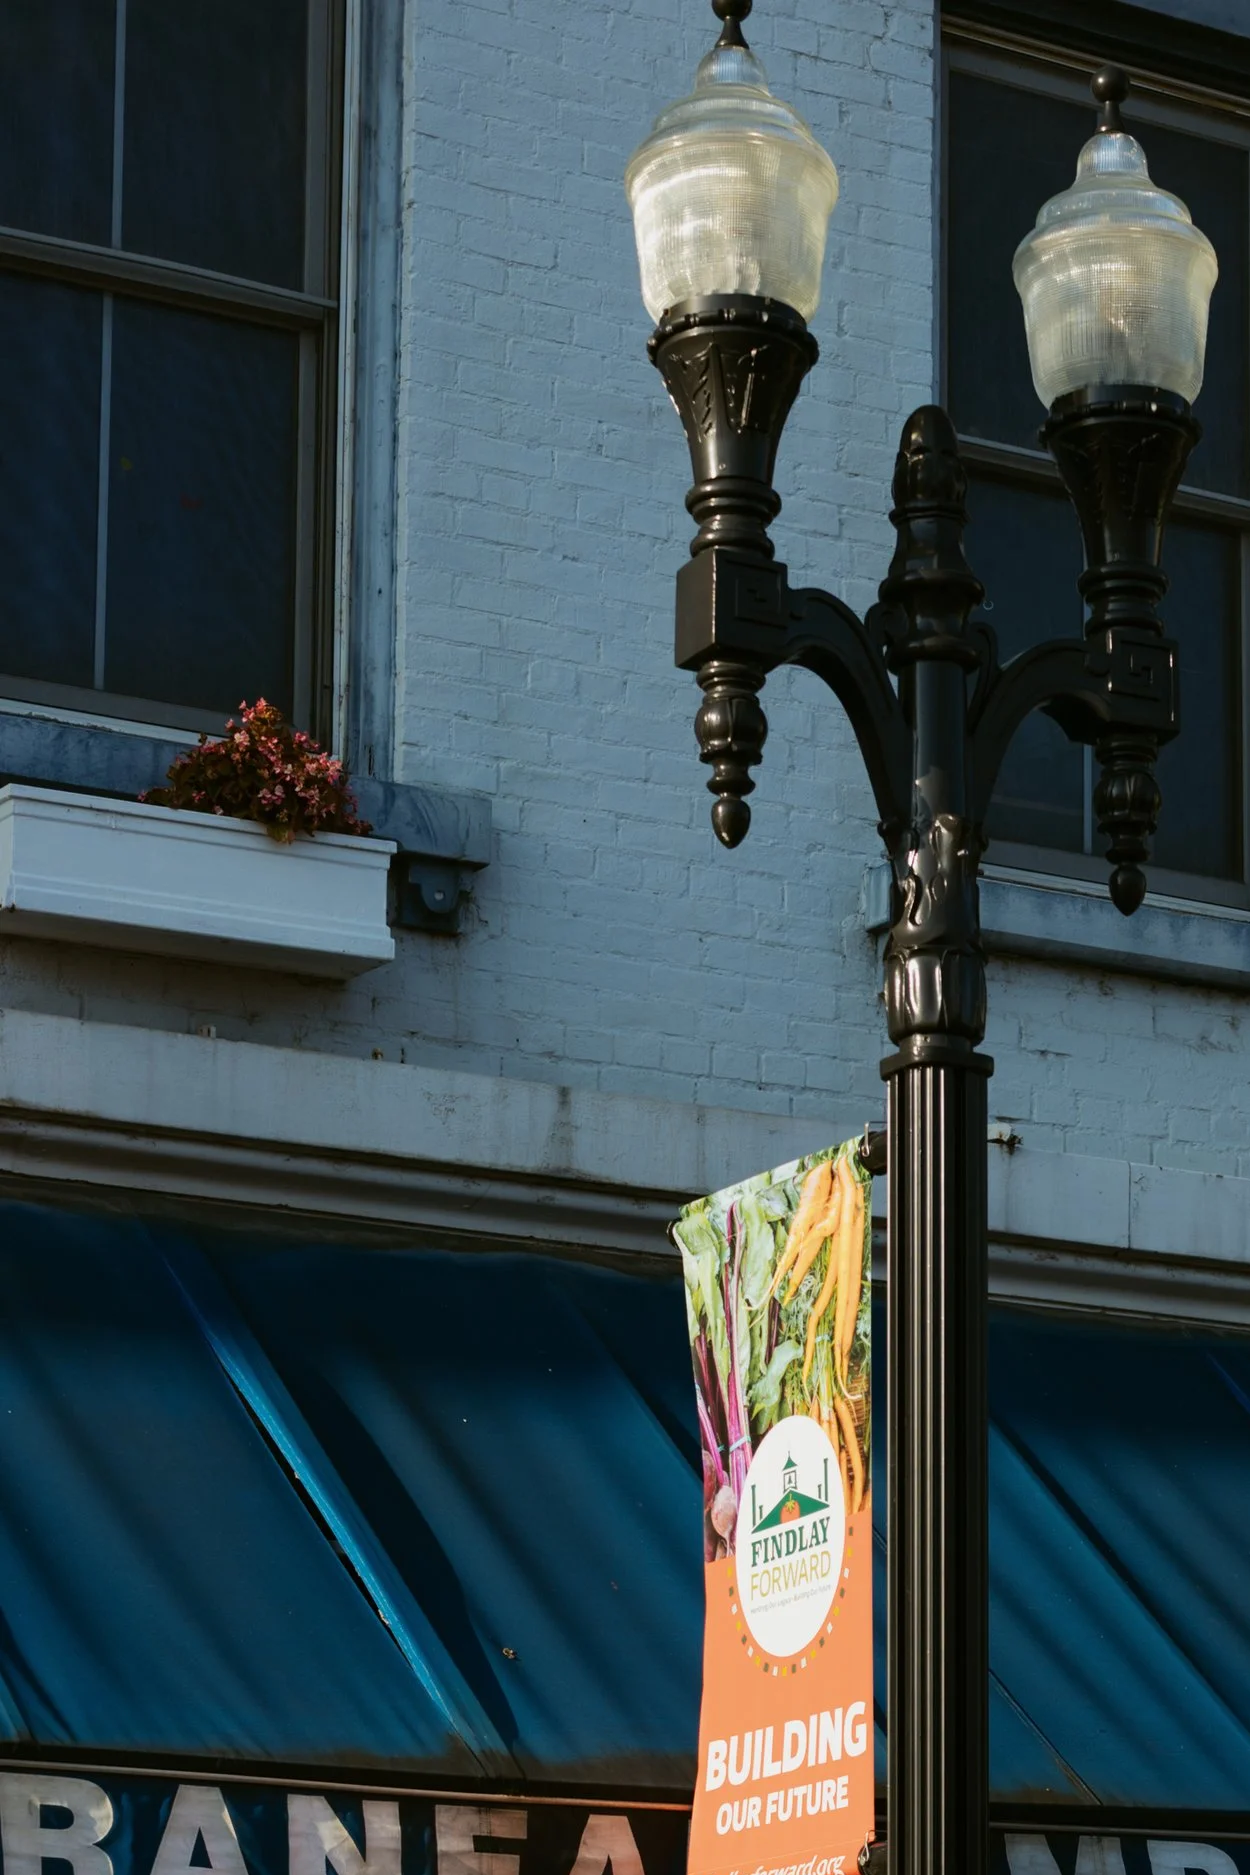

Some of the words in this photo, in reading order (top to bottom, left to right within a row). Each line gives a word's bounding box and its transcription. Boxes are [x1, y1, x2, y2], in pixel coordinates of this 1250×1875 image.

[750, 1516, 830, 1568] FINDLAY
[750, 1551, 831, 1601] FORWARD
[705, 1701, 867, 1792] BUILDING
[716, 1796, 761, 1836] OUR
[765, 1775, 849, 1825] FUTURE
